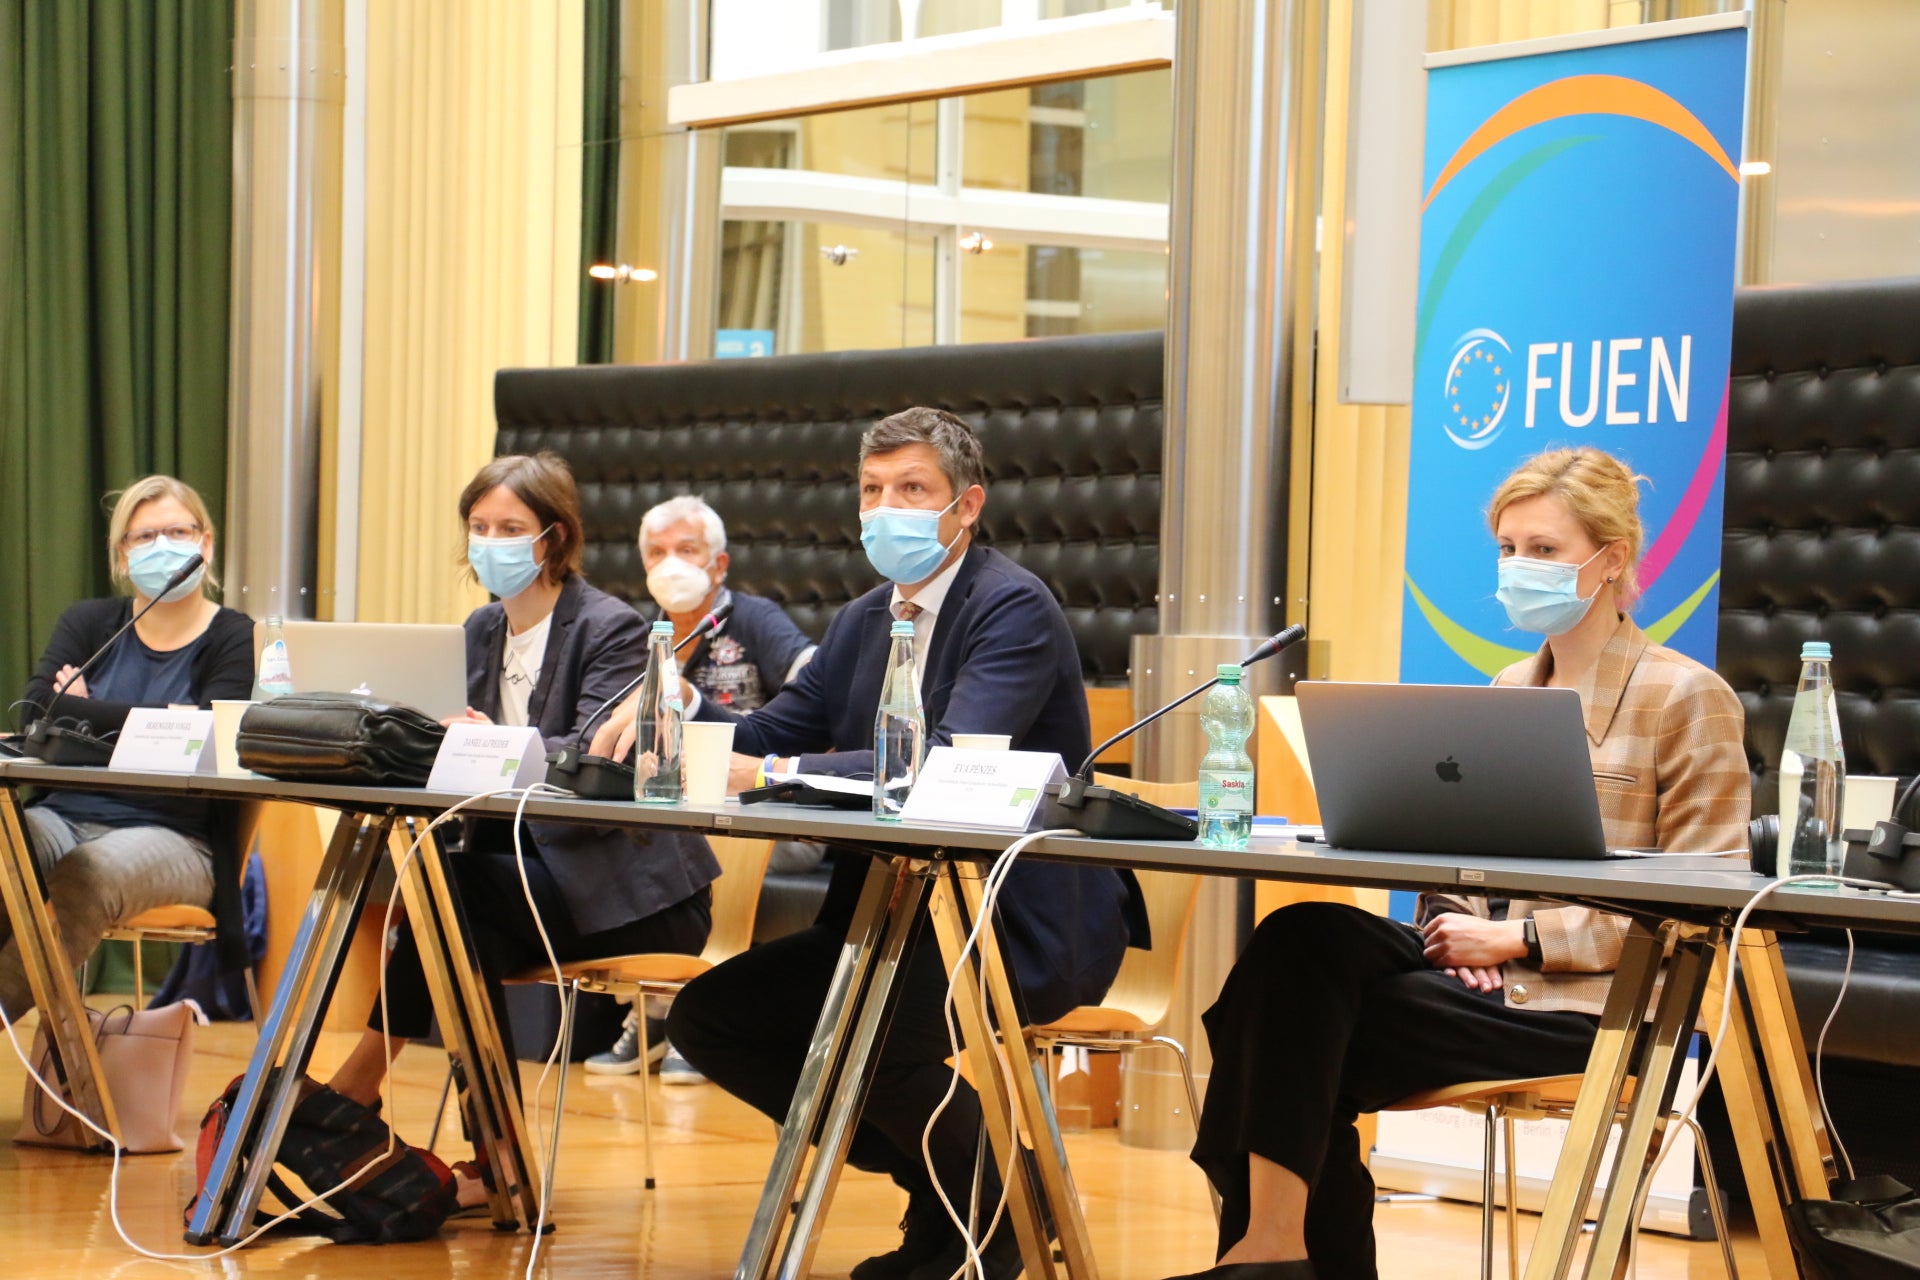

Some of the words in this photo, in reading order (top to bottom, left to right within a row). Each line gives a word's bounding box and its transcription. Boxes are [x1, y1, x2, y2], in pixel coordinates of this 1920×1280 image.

[1525, 335, 1692, 428] FUEN
[953, 763, 970, 774] EVA
[1222, 780, 1245, 789] Saskia
[1523, 1120, 1552, 1136] Berlin
